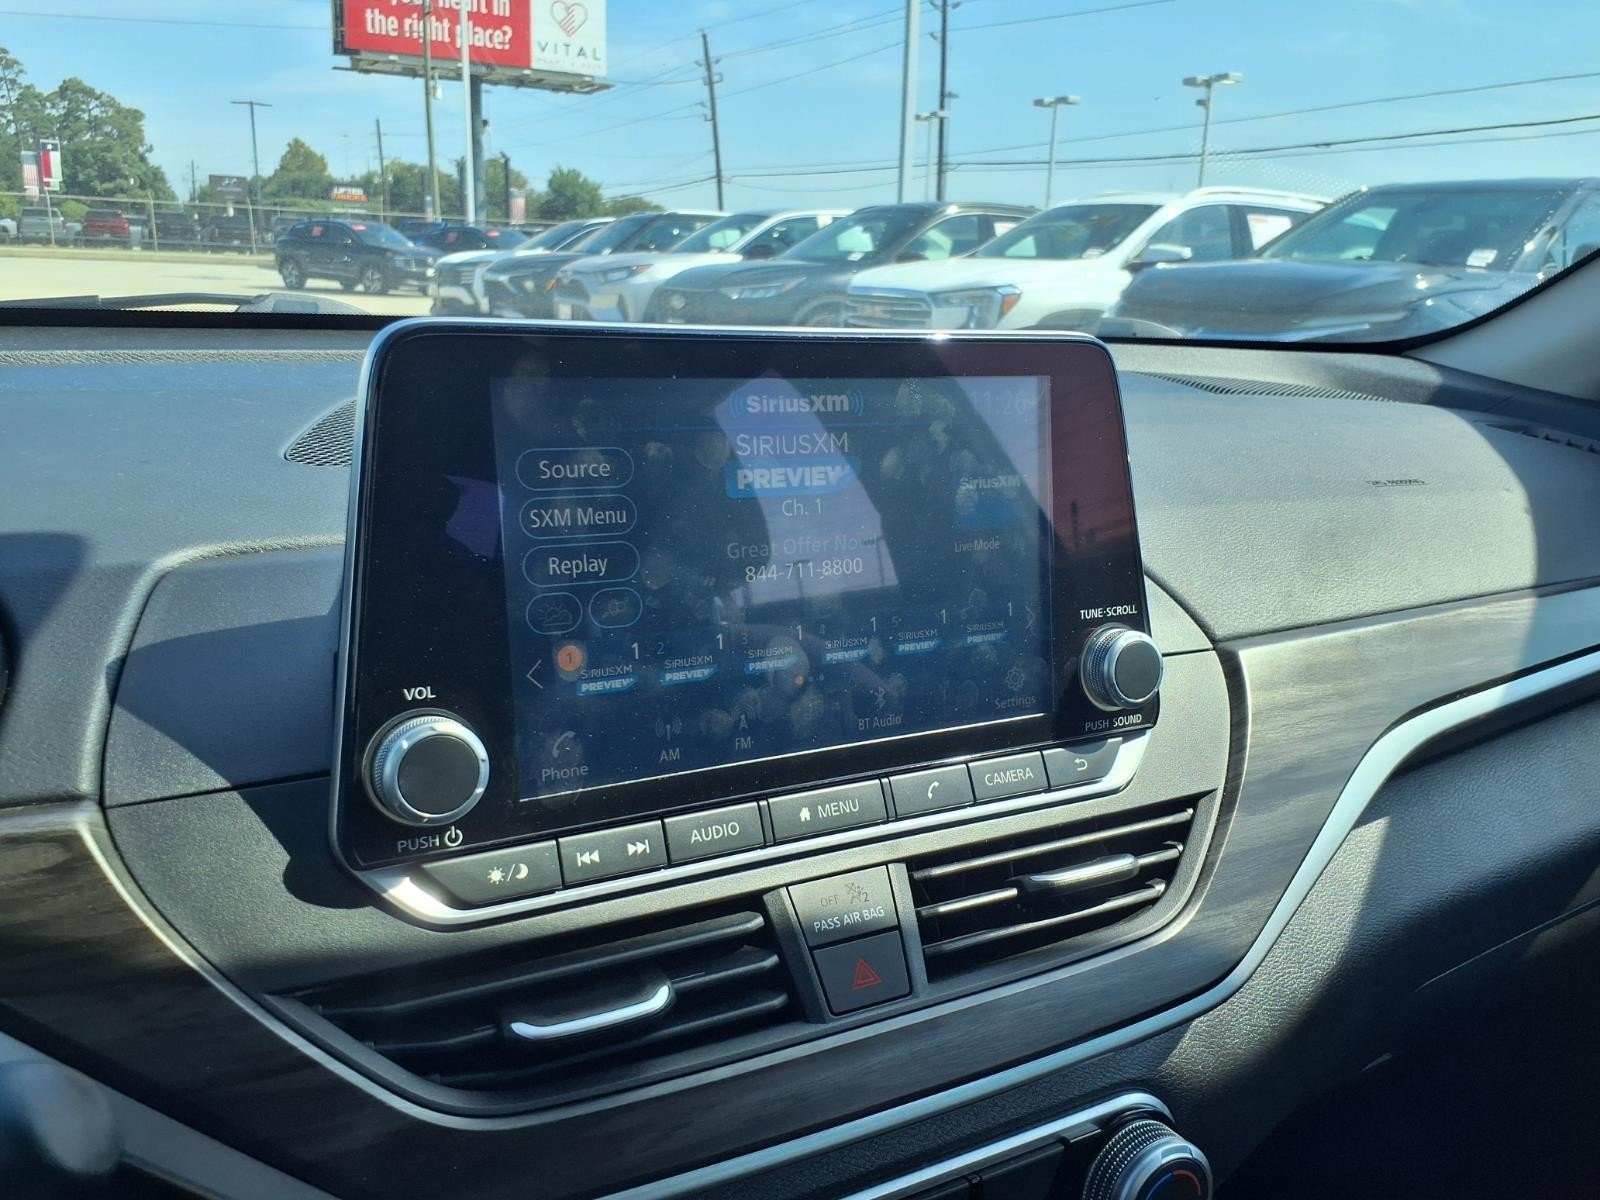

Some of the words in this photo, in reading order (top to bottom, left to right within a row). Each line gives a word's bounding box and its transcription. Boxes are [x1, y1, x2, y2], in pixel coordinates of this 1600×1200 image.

[365, 8, 398, 36] the
[537, 40, 602, 61] VITAL
[736, 432, 849, 456] SIRIUSXM
[539, 460, 611, 479] Source
[782, 499, 809, 517] Ch.
[816, 499, 822, 514] 1
[530, 508, 572, 528] SXM
[577, 507, 627, 526] Menu
[727, 541, 777, 559] Great
[783, 536, 832, 556] Offer
[549, 554, 608, 578] Replay
[745, 557, 864, 583] 844-711-8800
[939, 608, 946, 624] 1
[1007, 601, 1013, 617] 1
[795, 624, 802, 640] 1
[869, 616, 877, 632] 1
[715, 633, 723, 650] 1
[566, 652, 573, 665] 1
[631, 642, 640, 660] 1
[403, 686, 437, 701] VOL
[994, 695, 1036, 709] Settings
[858, 719, 870, 731] BT
[873, 714, 902, 728] Audio
[1085, 718, 1109, 731] PUSH
[1112, 713, 1142, 727] SOUND
[735, 736, 752, 750] FM
[660, 749, 680, 762] AM
[541, 765, 589, 782] Phone
[984, 767, 1034, 786] CAMERA
[817, 798, 860, 818] MENU
[690, 821, 740, 844] AUDIO
[397, 834, 439, 852] PUSH
[820, 894, 839, 907] OFF
[813, 916, 841, 933] PASS
[843, 911, 862, 926] AIR
[862, 905, 885, 921] BAG
